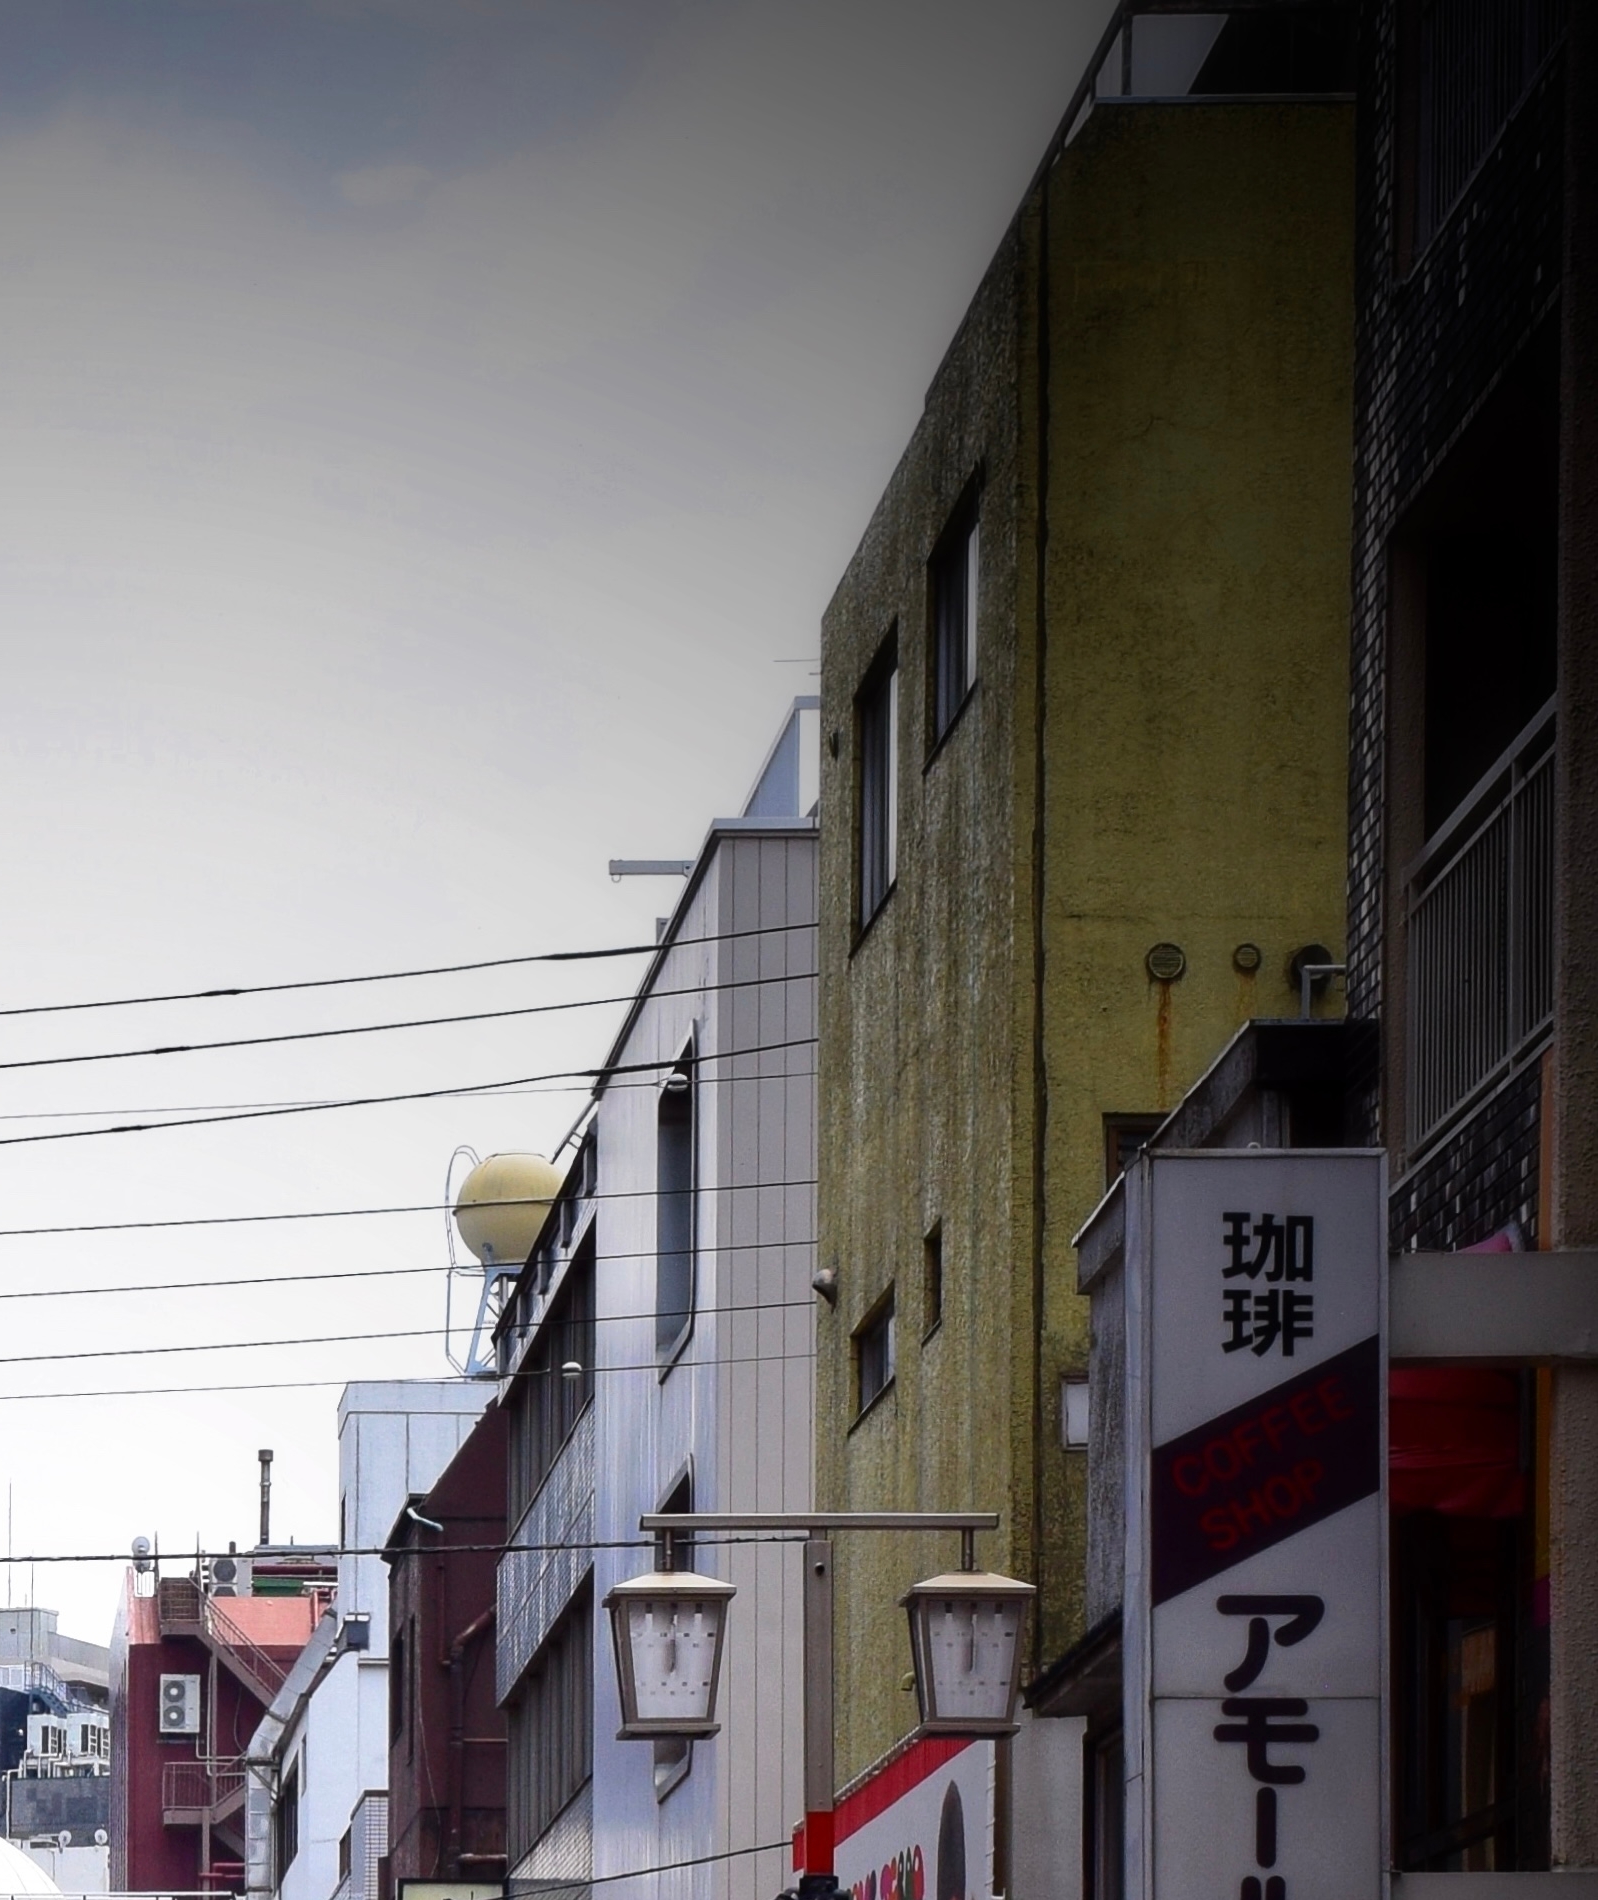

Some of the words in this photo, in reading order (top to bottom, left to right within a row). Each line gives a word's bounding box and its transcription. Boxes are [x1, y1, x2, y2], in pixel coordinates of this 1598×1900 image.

[1222, 1211, 1315, 1357] 珈琲
[1170, 1373, 1358, 1500] COFFEE
[1199, 1458, 1324, 1553] SHOP
